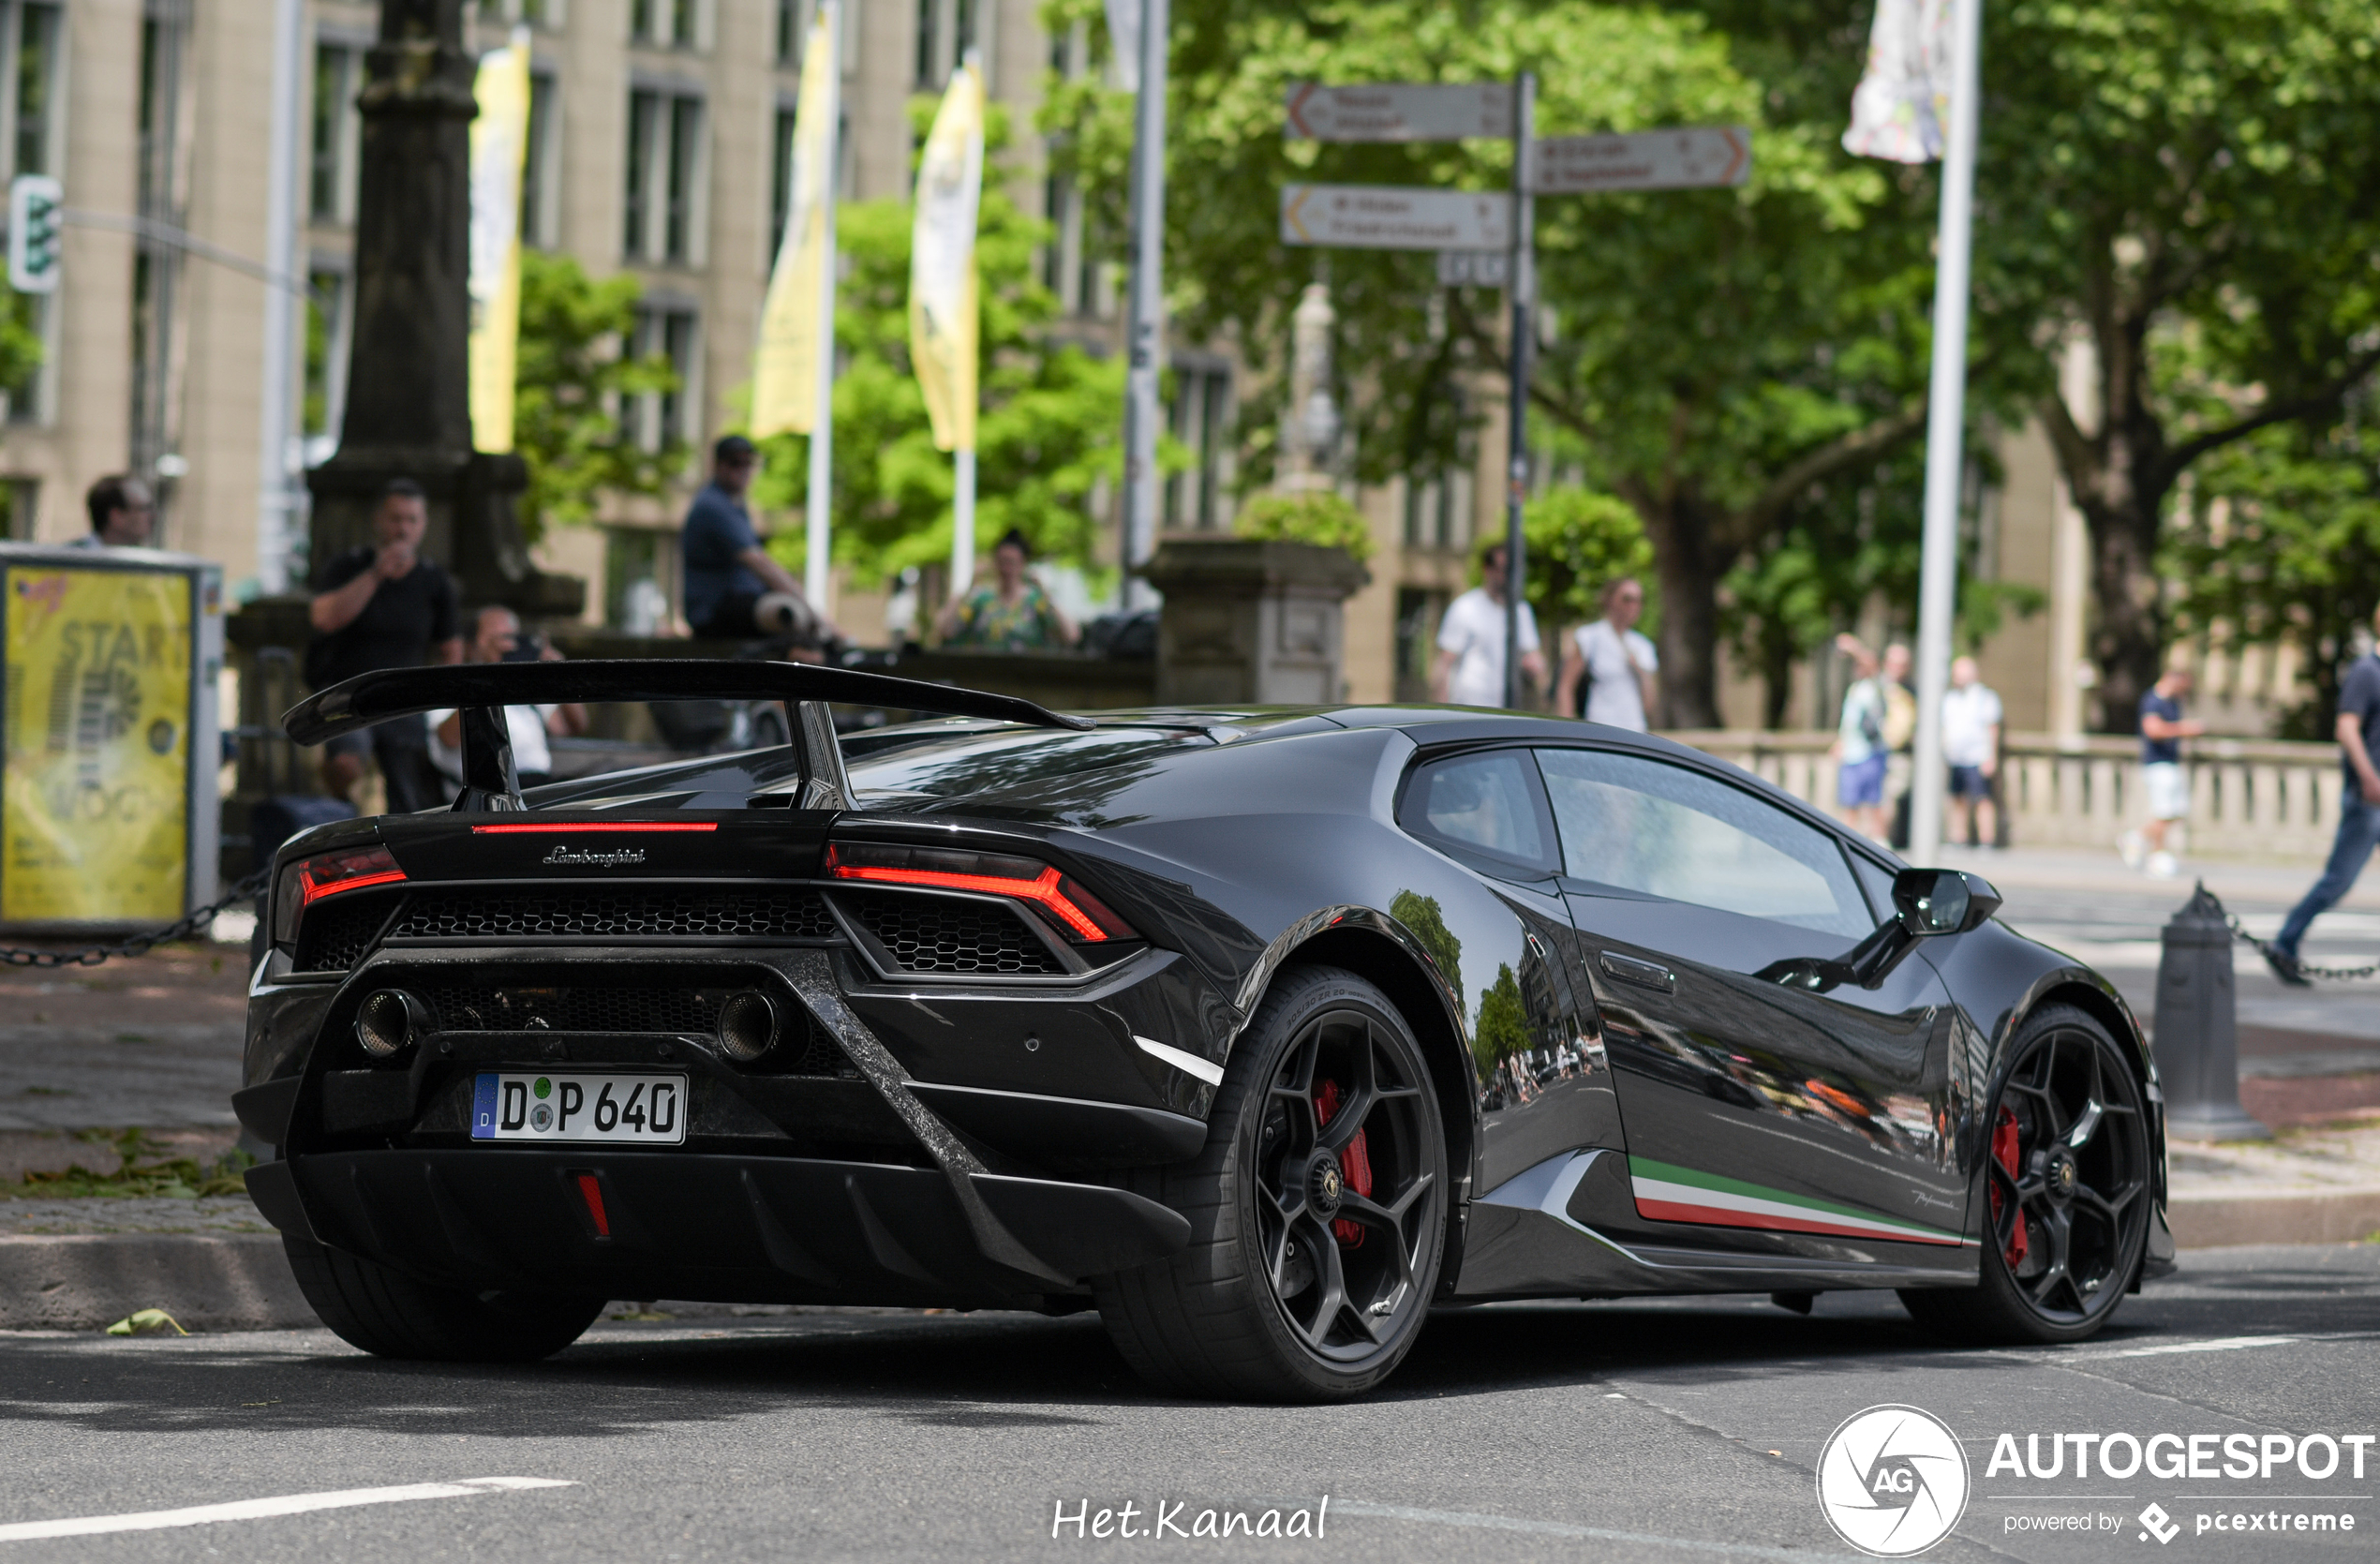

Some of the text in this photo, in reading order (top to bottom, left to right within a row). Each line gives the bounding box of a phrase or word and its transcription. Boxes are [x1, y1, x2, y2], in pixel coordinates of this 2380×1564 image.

[543, 845, 646, 868] Lamborghini
[1286, 997, 1316, 1030] 305/30
[1317, 990, 1331, 1001] ZR
[1332, 988, 1346, 997] 20
[480, 1112, 490, 1127] D
[500, 1081, 528, 1131] D
[558, 1081, 585, 1132] P
[594, 1081, 677, 1133] 640
